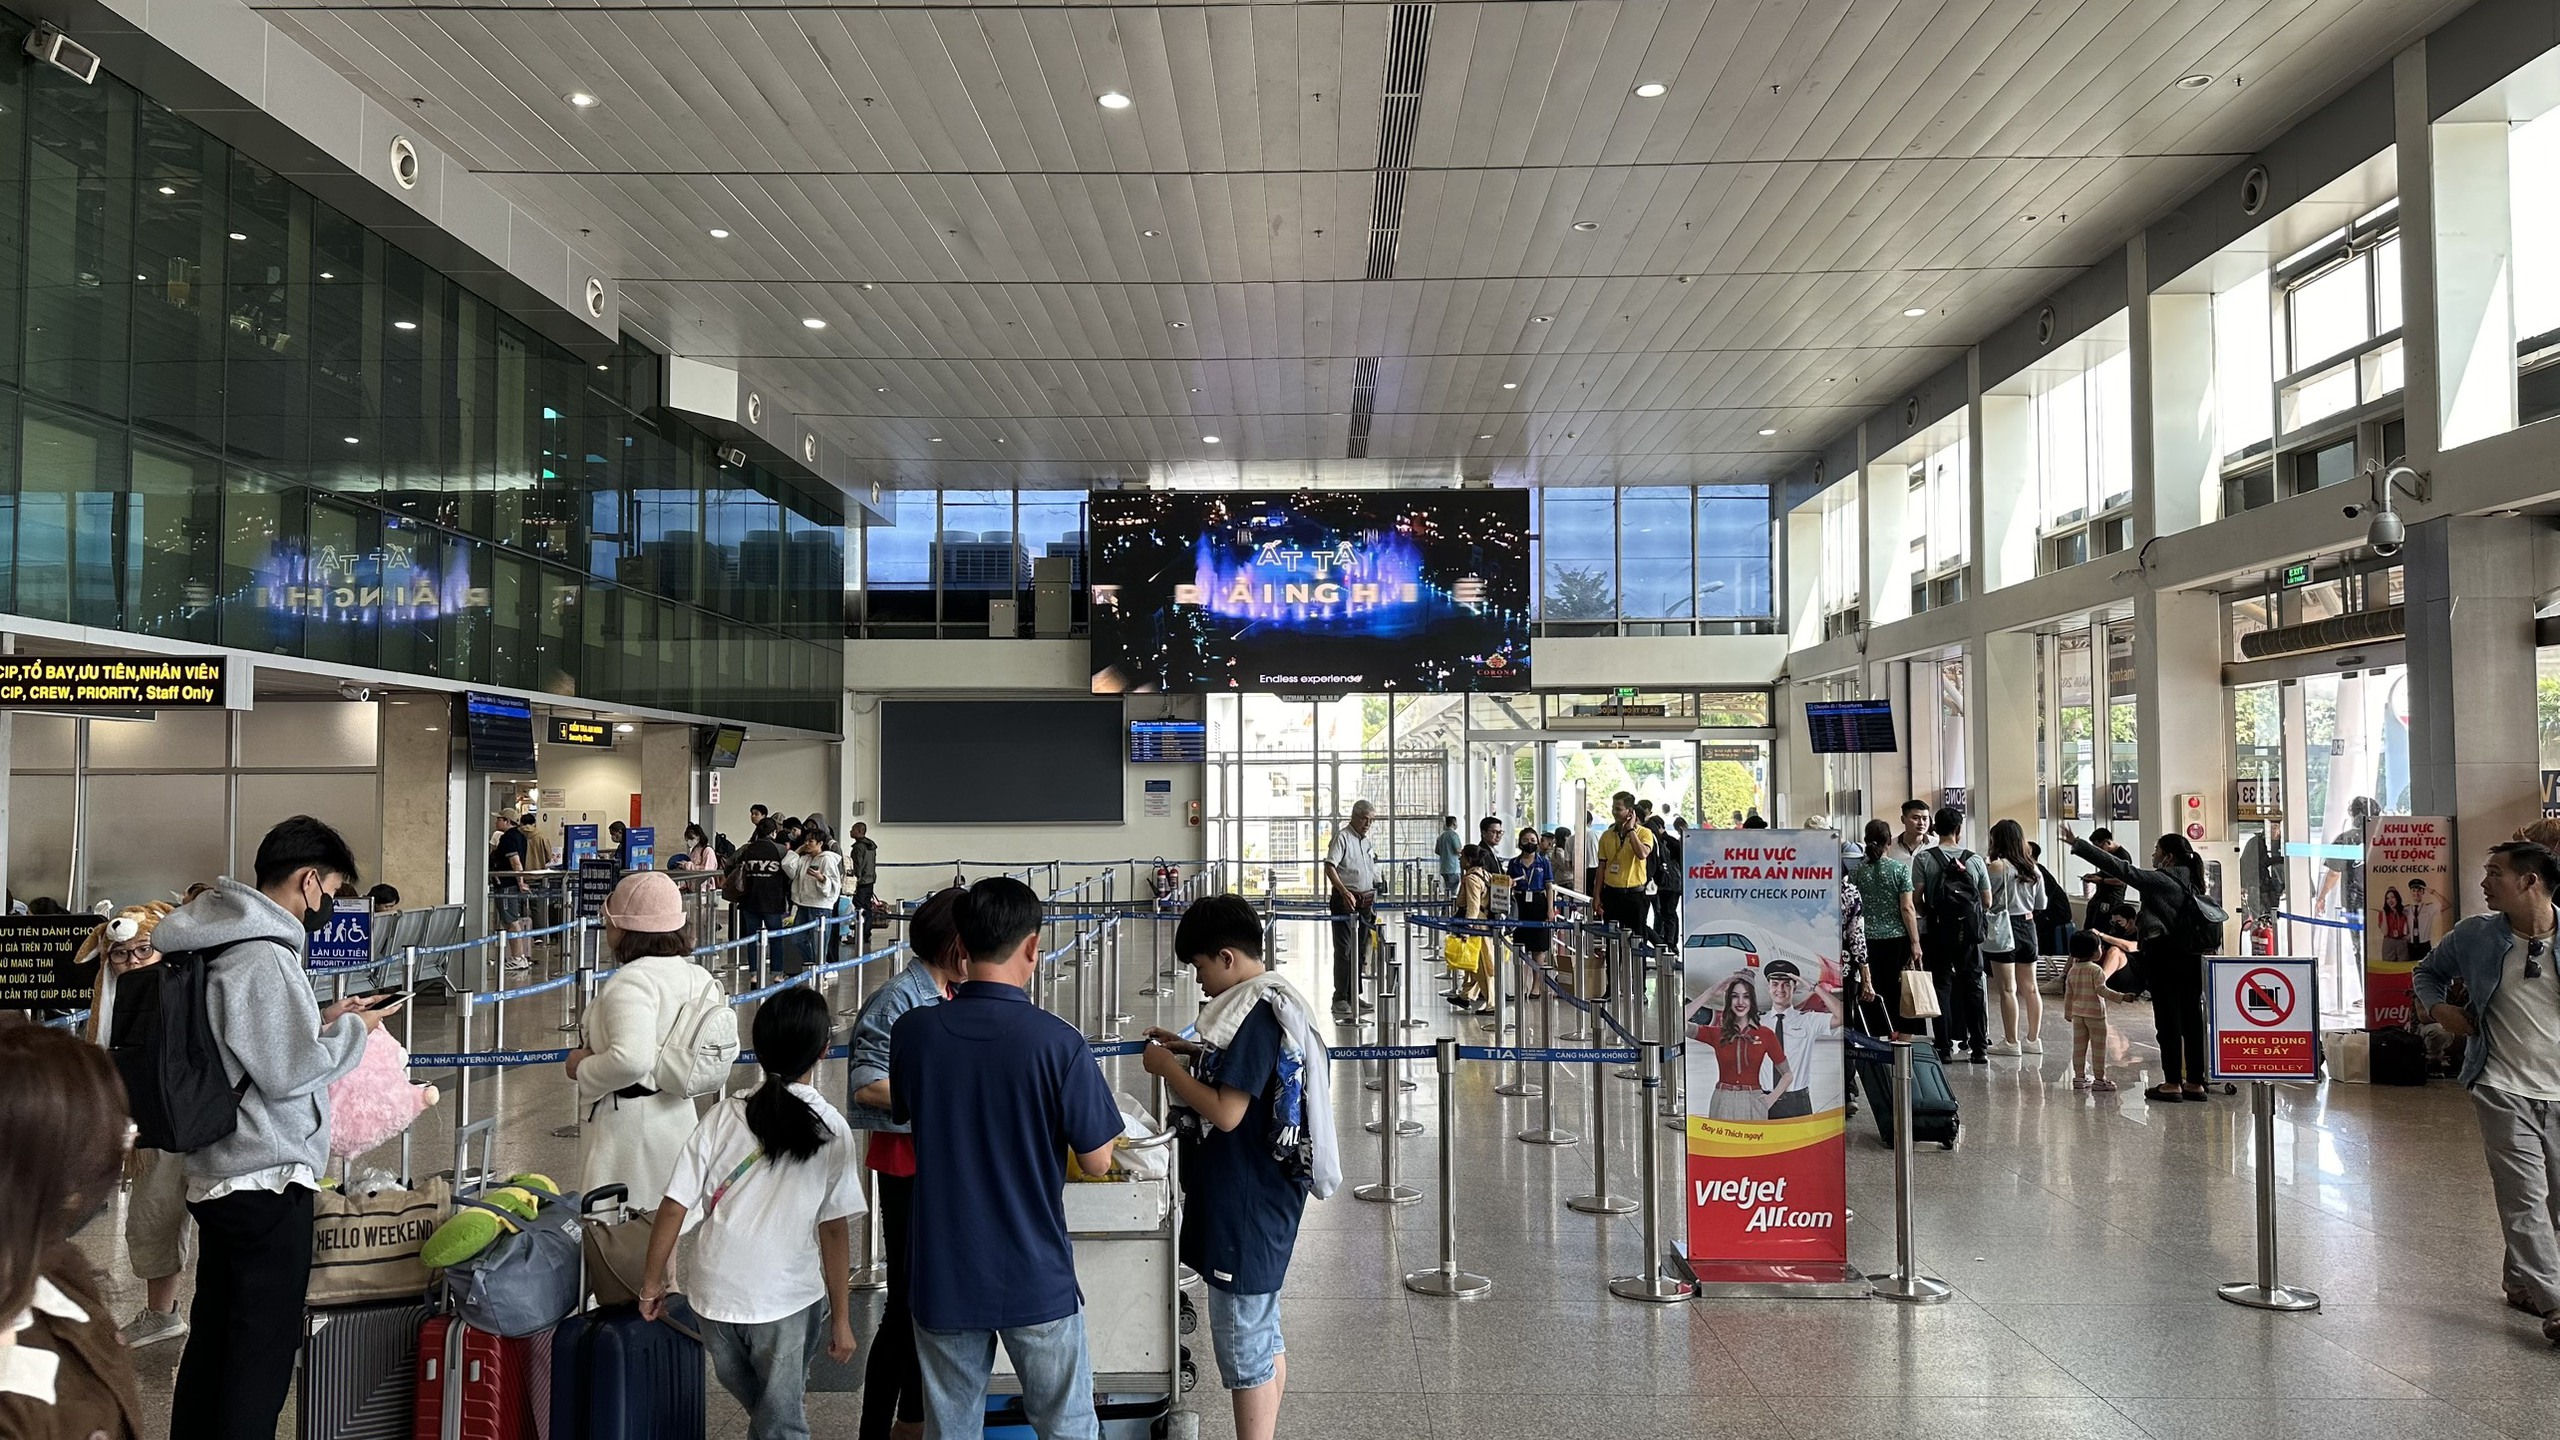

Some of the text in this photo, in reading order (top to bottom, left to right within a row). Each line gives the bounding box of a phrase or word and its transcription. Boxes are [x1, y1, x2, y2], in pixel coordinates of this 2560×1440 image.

[2288, 566, 2304, 577] EXIT
[46, 663, 99, 681] BAY,ƯU
[103, 662, 181, 682] TIÊN,NHÂN
[185, 662, 219, 680] VIÊN
[1260, 674, 1298, 684] Endless
[1, 685, 214, 702] CIP, CREW, PRIORITY, Staff Only
[2383, 822, 2434, 836] KHU VỰC
[2372, 834, 2397, 846] LÀM
[2423, 836, 2446, 849] TỤC
[1724, 845, 1797, 865] KHU VỰC
[2383, 847, 2435, 863] TỰ ĐỘNG
[1688, 859, 1833, 879] KIỂM TRA AN NINH
[2372, 864, 2398, 873] KIOSK
[2400, 864, 2430, 873] CHECK
[2436, 864, 2447, 873] IN
[1694, 888, 1827, 899] SECURITY CHECK POINT
[17, 925, 40, 937] TIÊN
[41, 925, 70, 937] DÀNH
[72, 926, 95, 936] CHO
[5, 939, 73, 952] GIÀ TRÊN 70 TUỔI
[311, 945, 368, 957] LÀN ƯU TIÊN
[10, 958, 34, 968] MANG
[36, 958, 54, 967] THAI
[310, 959, 346, 967] PRIORITY
[9, 973, 28, 984] DƯỚI
[29, 974, 35, 983] 2
[37, 970, 55, 983] TUỔI
[305, 968, 318, 976] TIA
[492, 993, 506, 1001] TIA
[2222, 1035, 2307, 1044] KHÔNG DÙNG
[433, 1056, 455, 1064] NHAT
[456, 1055, 522, 1064] INTERNATIONAL
[522, 1052, 559, 1062] AIRPORT
[1483, 1048, 1517, 1059] TIA
[1579, 1050, 1600, 1059] HÀNG
[1602, 1050, 1629, 1059] KHÔNG
[1701, 1122, 1764, 1141] Bay là Thích ngay!
[316, 1218, 433, 1252] HELLO WEEKEND
